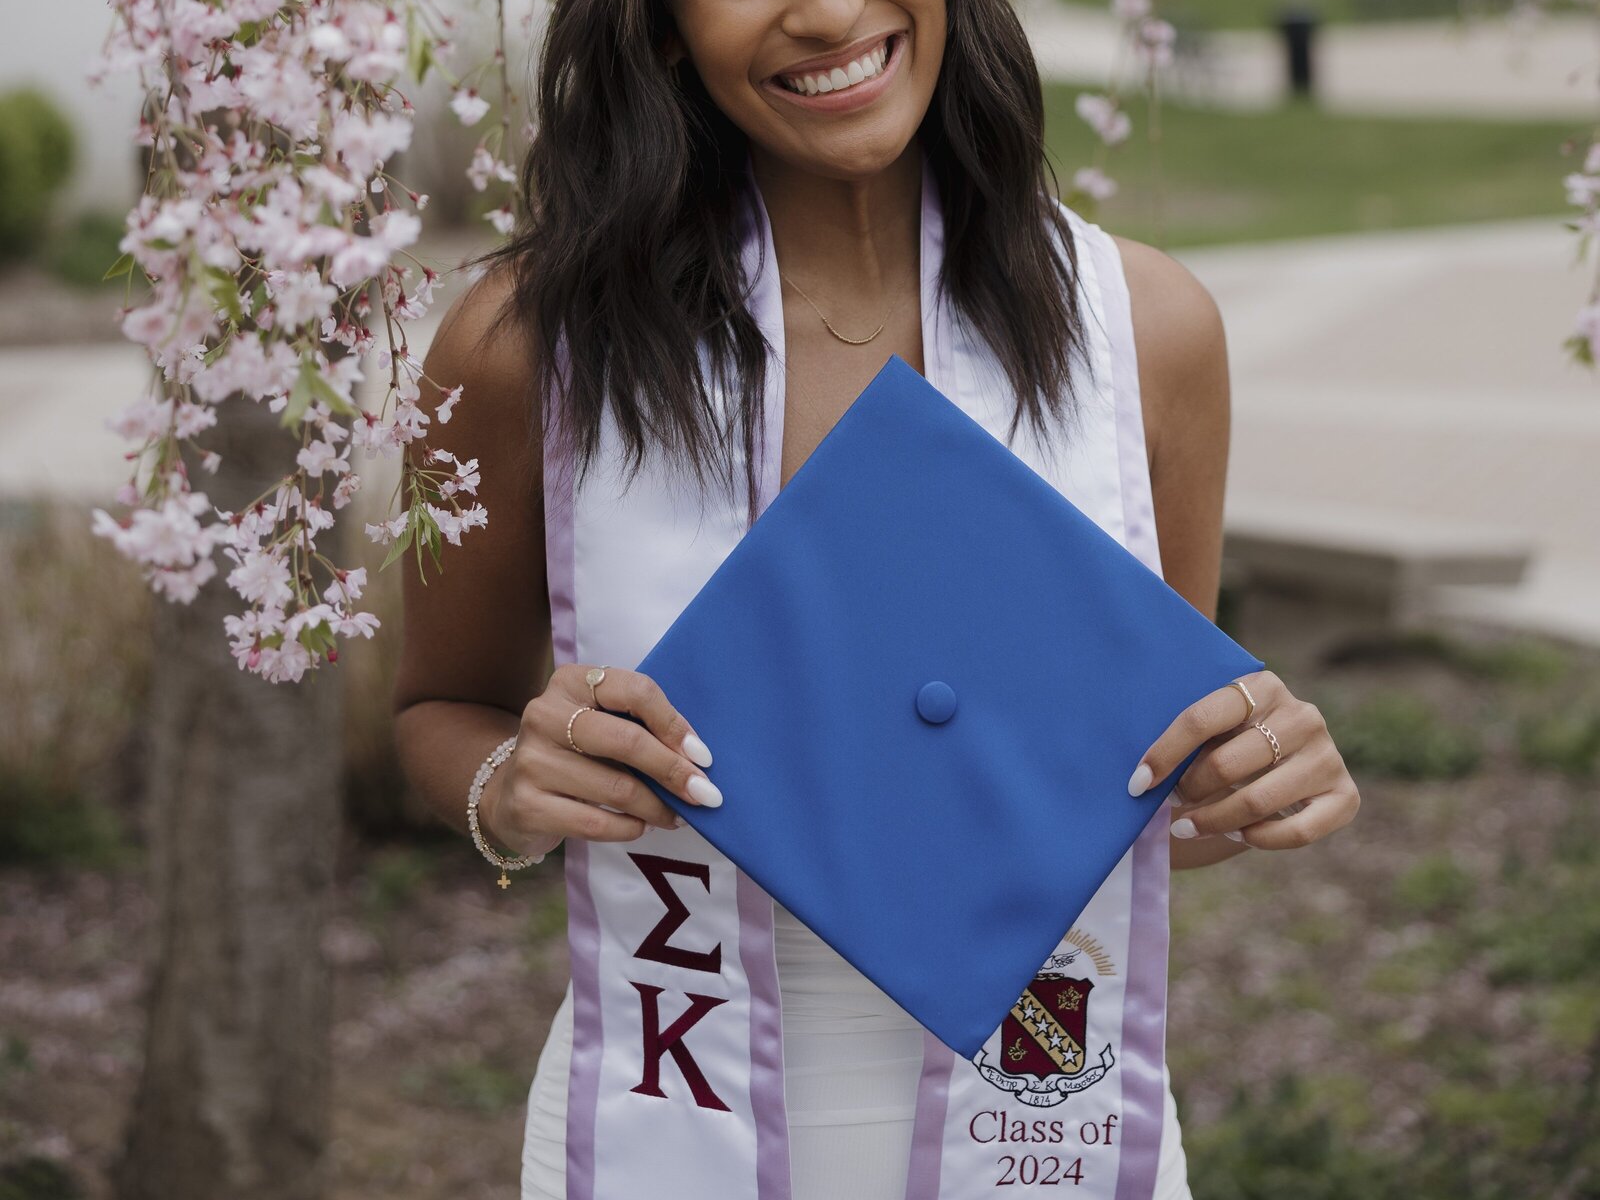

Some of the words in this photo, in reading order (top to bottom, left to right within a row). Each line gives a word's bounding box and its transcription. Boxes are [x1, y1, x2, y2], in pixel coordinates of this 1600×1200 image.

[627, 852, 721, 974] Σ
[1028, 1094, 1051, 1106] 1874
[969, 1110, 1064, 1144] Class
[1080, 1114, 1118, 1145] of
[995, 1154, 1085, 1187] 2024
